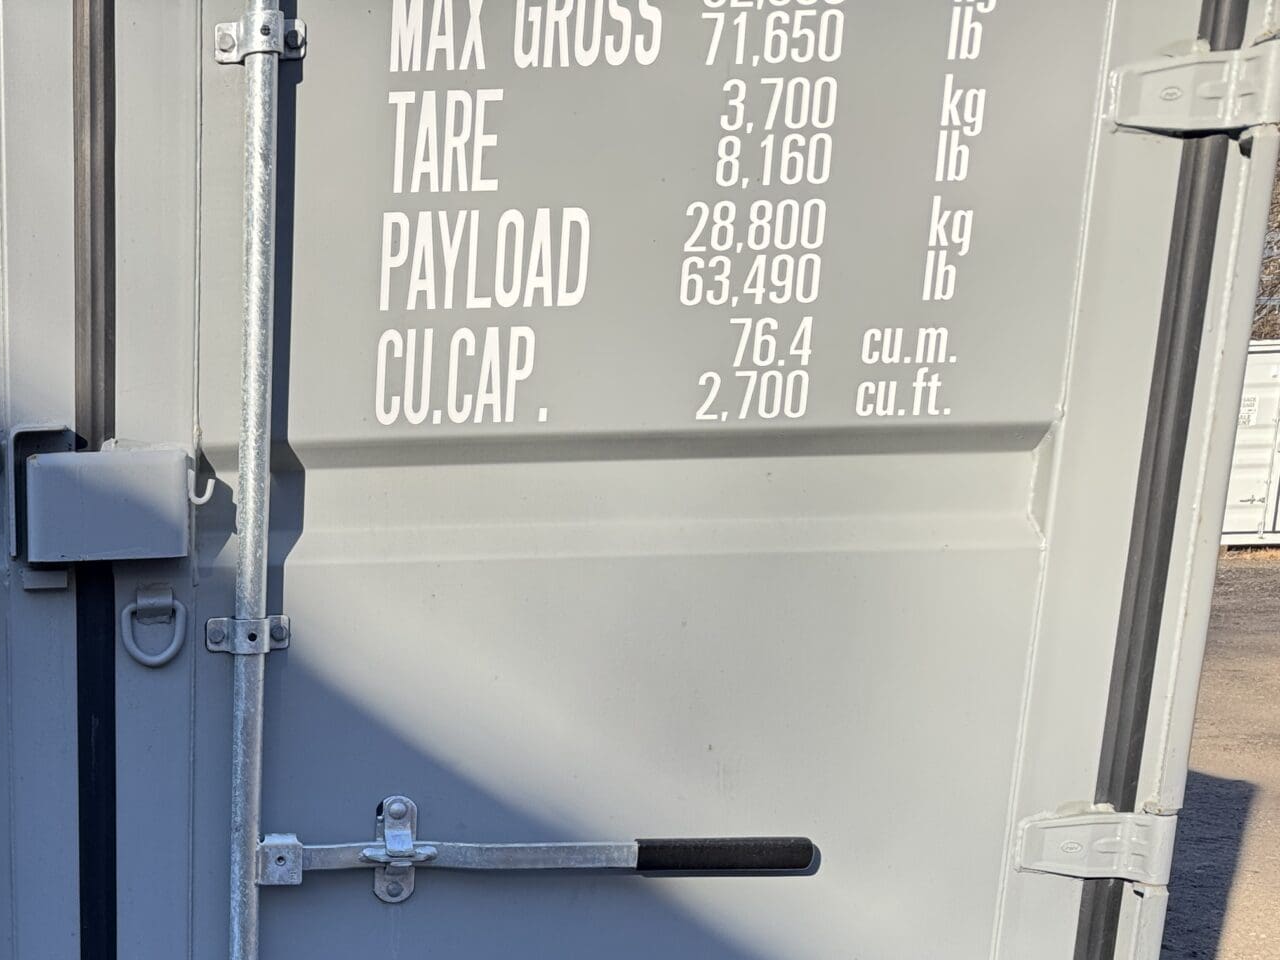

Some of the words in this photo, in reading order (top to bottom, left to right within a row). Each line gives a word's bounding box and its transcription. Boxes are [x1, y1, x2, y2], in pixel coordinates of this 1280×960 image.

[389, 0, 486, 72] MAX
[513, 0, 663, 69] GROSS
[701, 9, 844, 67] 71,650
[947, 5, 984, 60] lb
[388, 88, 504, 194] TARE
[720, 76, 838, 134] 3,700
[940, 74, 986, 136] kg
[715, 133, 833, 189] 8,160
[935, 131, 971, 182] lb
[379, 207, 590, 311] PAYLOAD
[683, 198, 827, 254] 28,800
[927, 195, 974, 256] kg
[679, 253, 822, 308] 63,490
[922, 249, 957, 301] lb
[729, 316, 813, 368] 76.4
[861, 326, 957, 365] cu.m.
[695, 369, 810, 422] 2,700
[855, 367, 951, 417] cu.ft.
